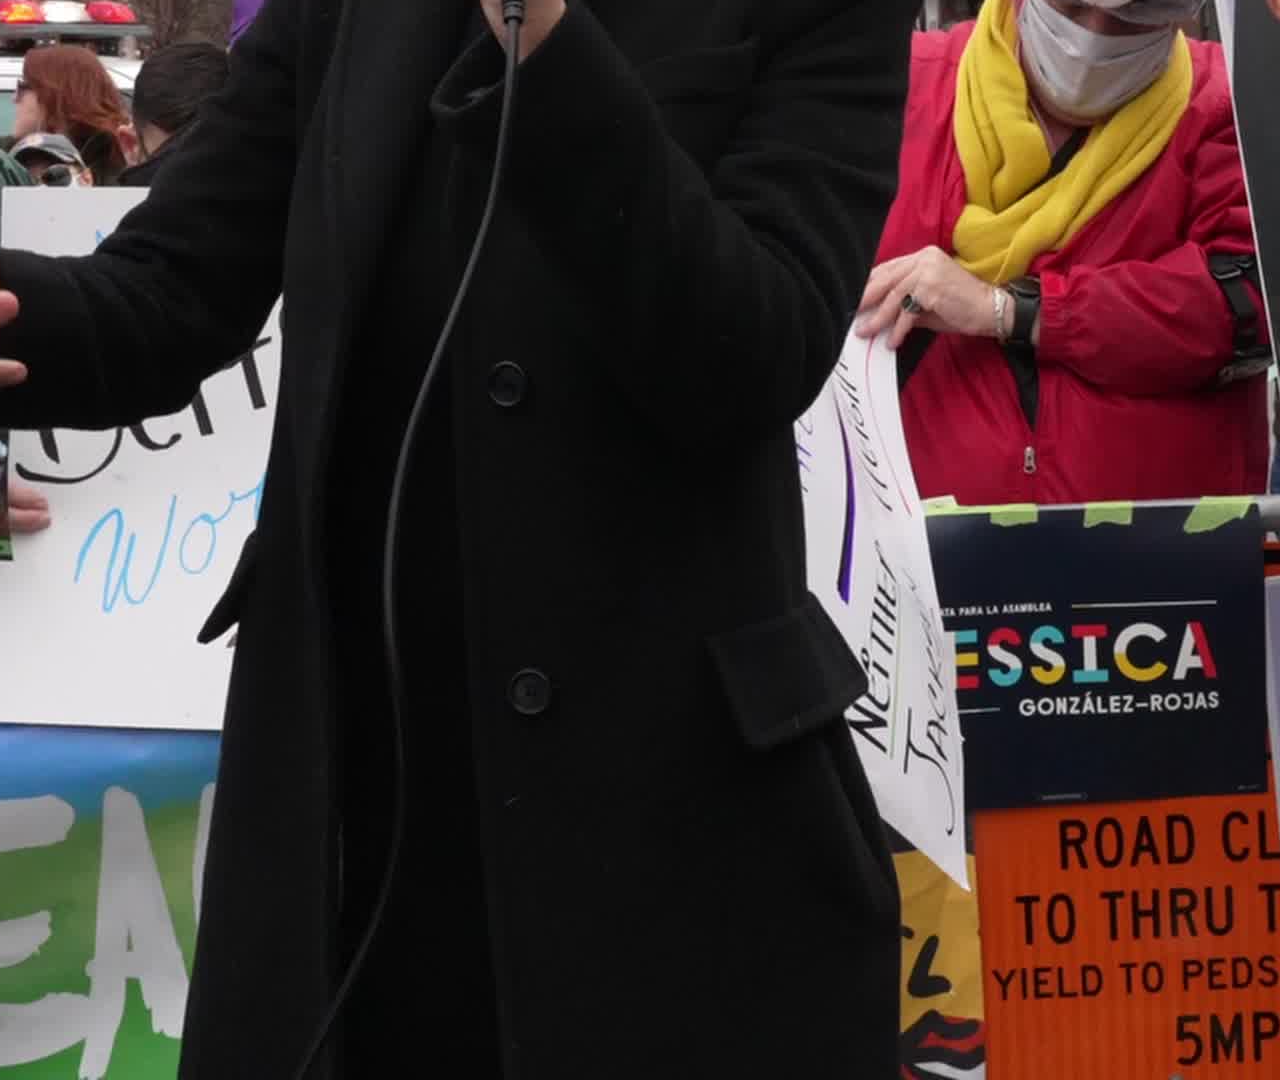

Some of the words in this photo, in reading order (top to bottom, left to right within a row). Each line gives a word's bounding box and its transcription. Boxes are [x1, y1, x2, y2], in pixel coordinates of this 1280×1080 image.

[959, 606, 983, 617] PARA
[986, 605, 999, 615] LA
[1002, 602, 1053, 615] ASAMBLEA
[1059, 814, 1195, 870] ROAD
[1015, 893, 1076, 945] TO
[1100, 886, 1234, 941] THRU
[992, 964, 1104, 1001] YIELD
[1120, 961, 1165, 994] TO
[1182, 955, 1279, 991] PEDS
